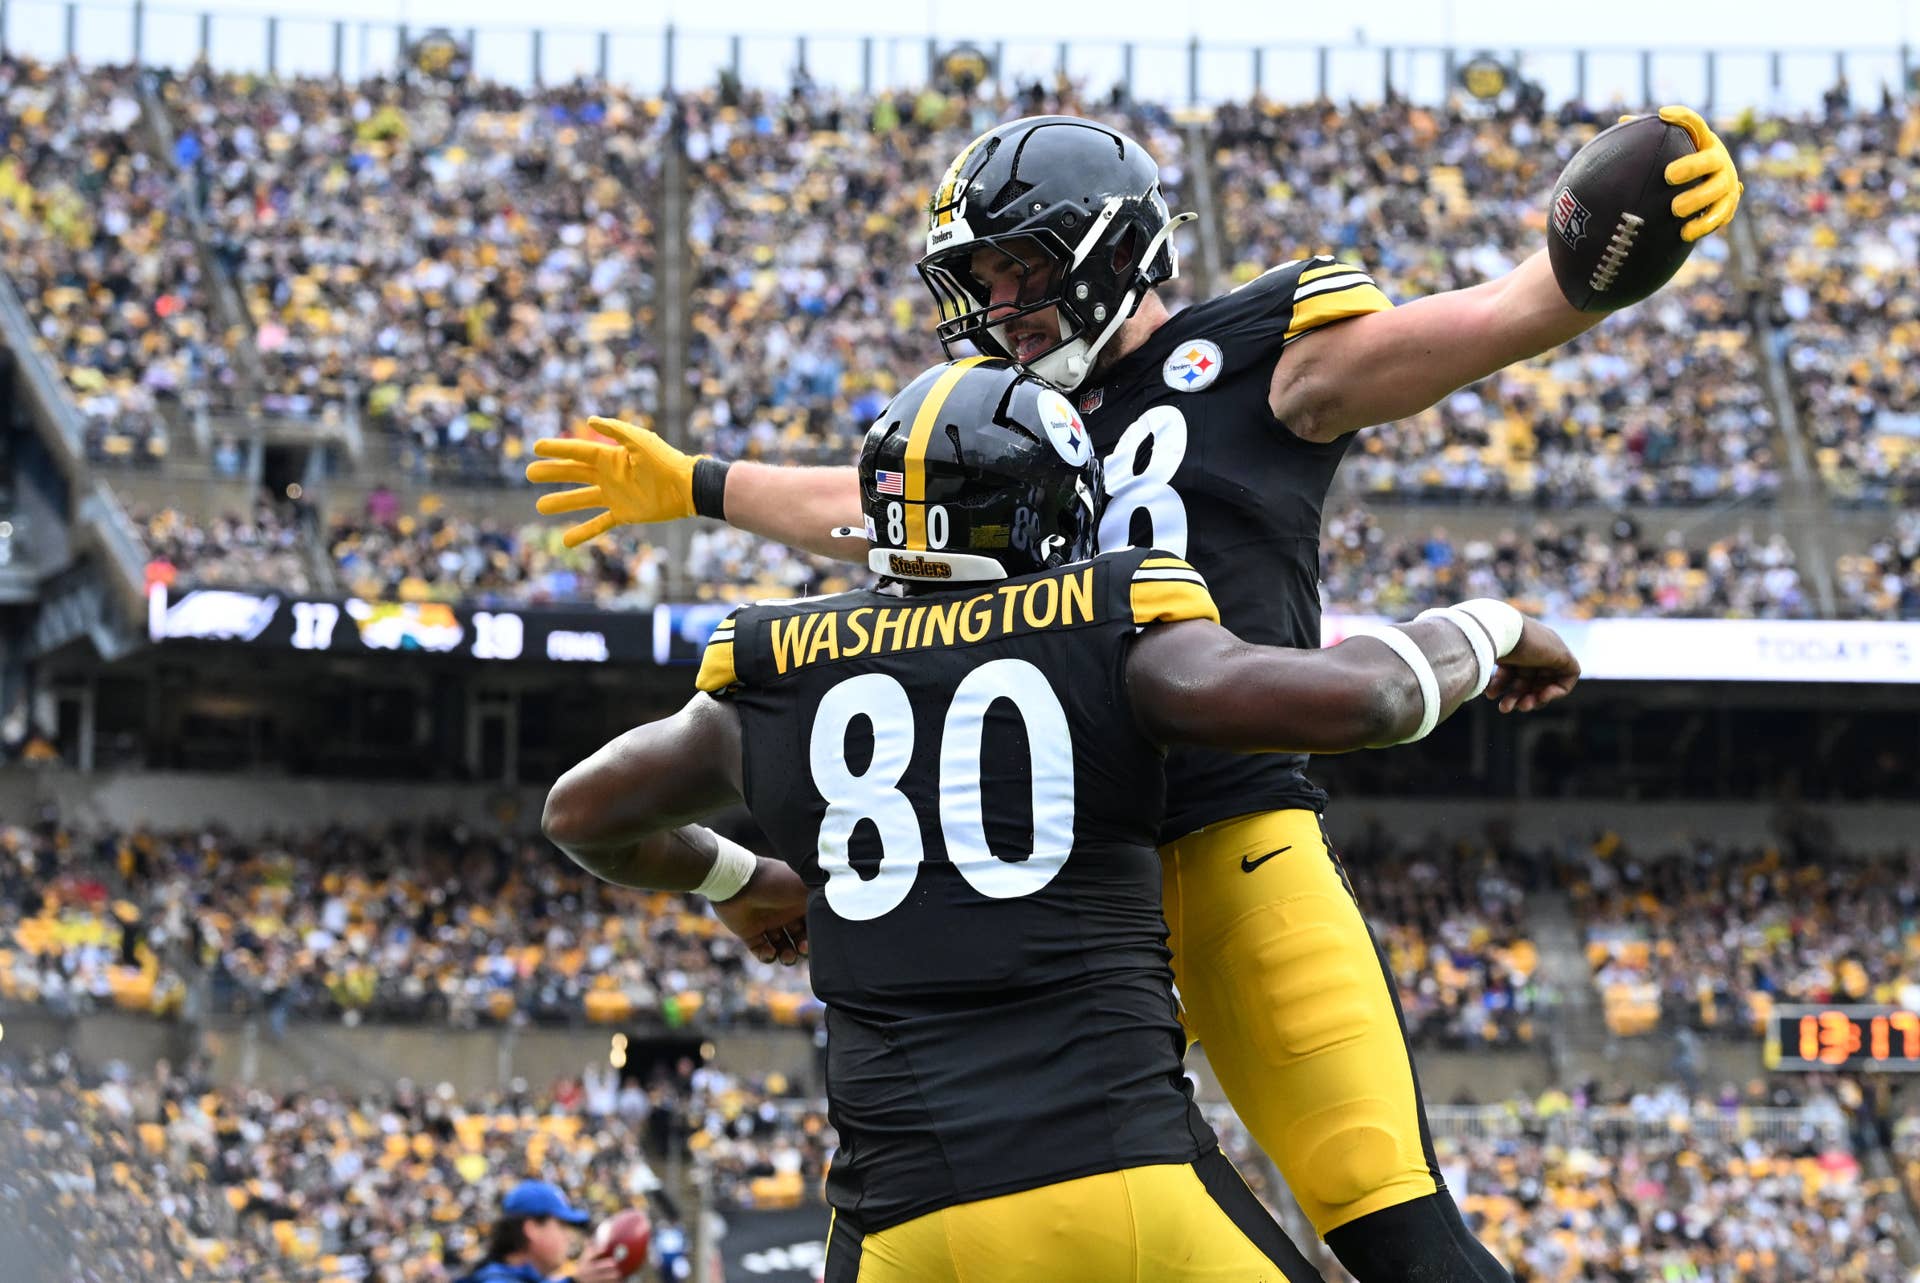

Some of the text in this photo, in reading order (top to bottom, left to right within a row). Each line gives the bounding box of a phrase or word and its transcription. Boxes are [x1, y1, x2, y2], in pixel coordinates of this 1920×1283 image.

[1553, 193, 1577, 228] NFL
[889, 554, 952, 579] Steelers
[291, 602, 339, 650] 17
[770, 567, 1095, 675] WASHINGTON
[810, 658, 1075, 921] 80
